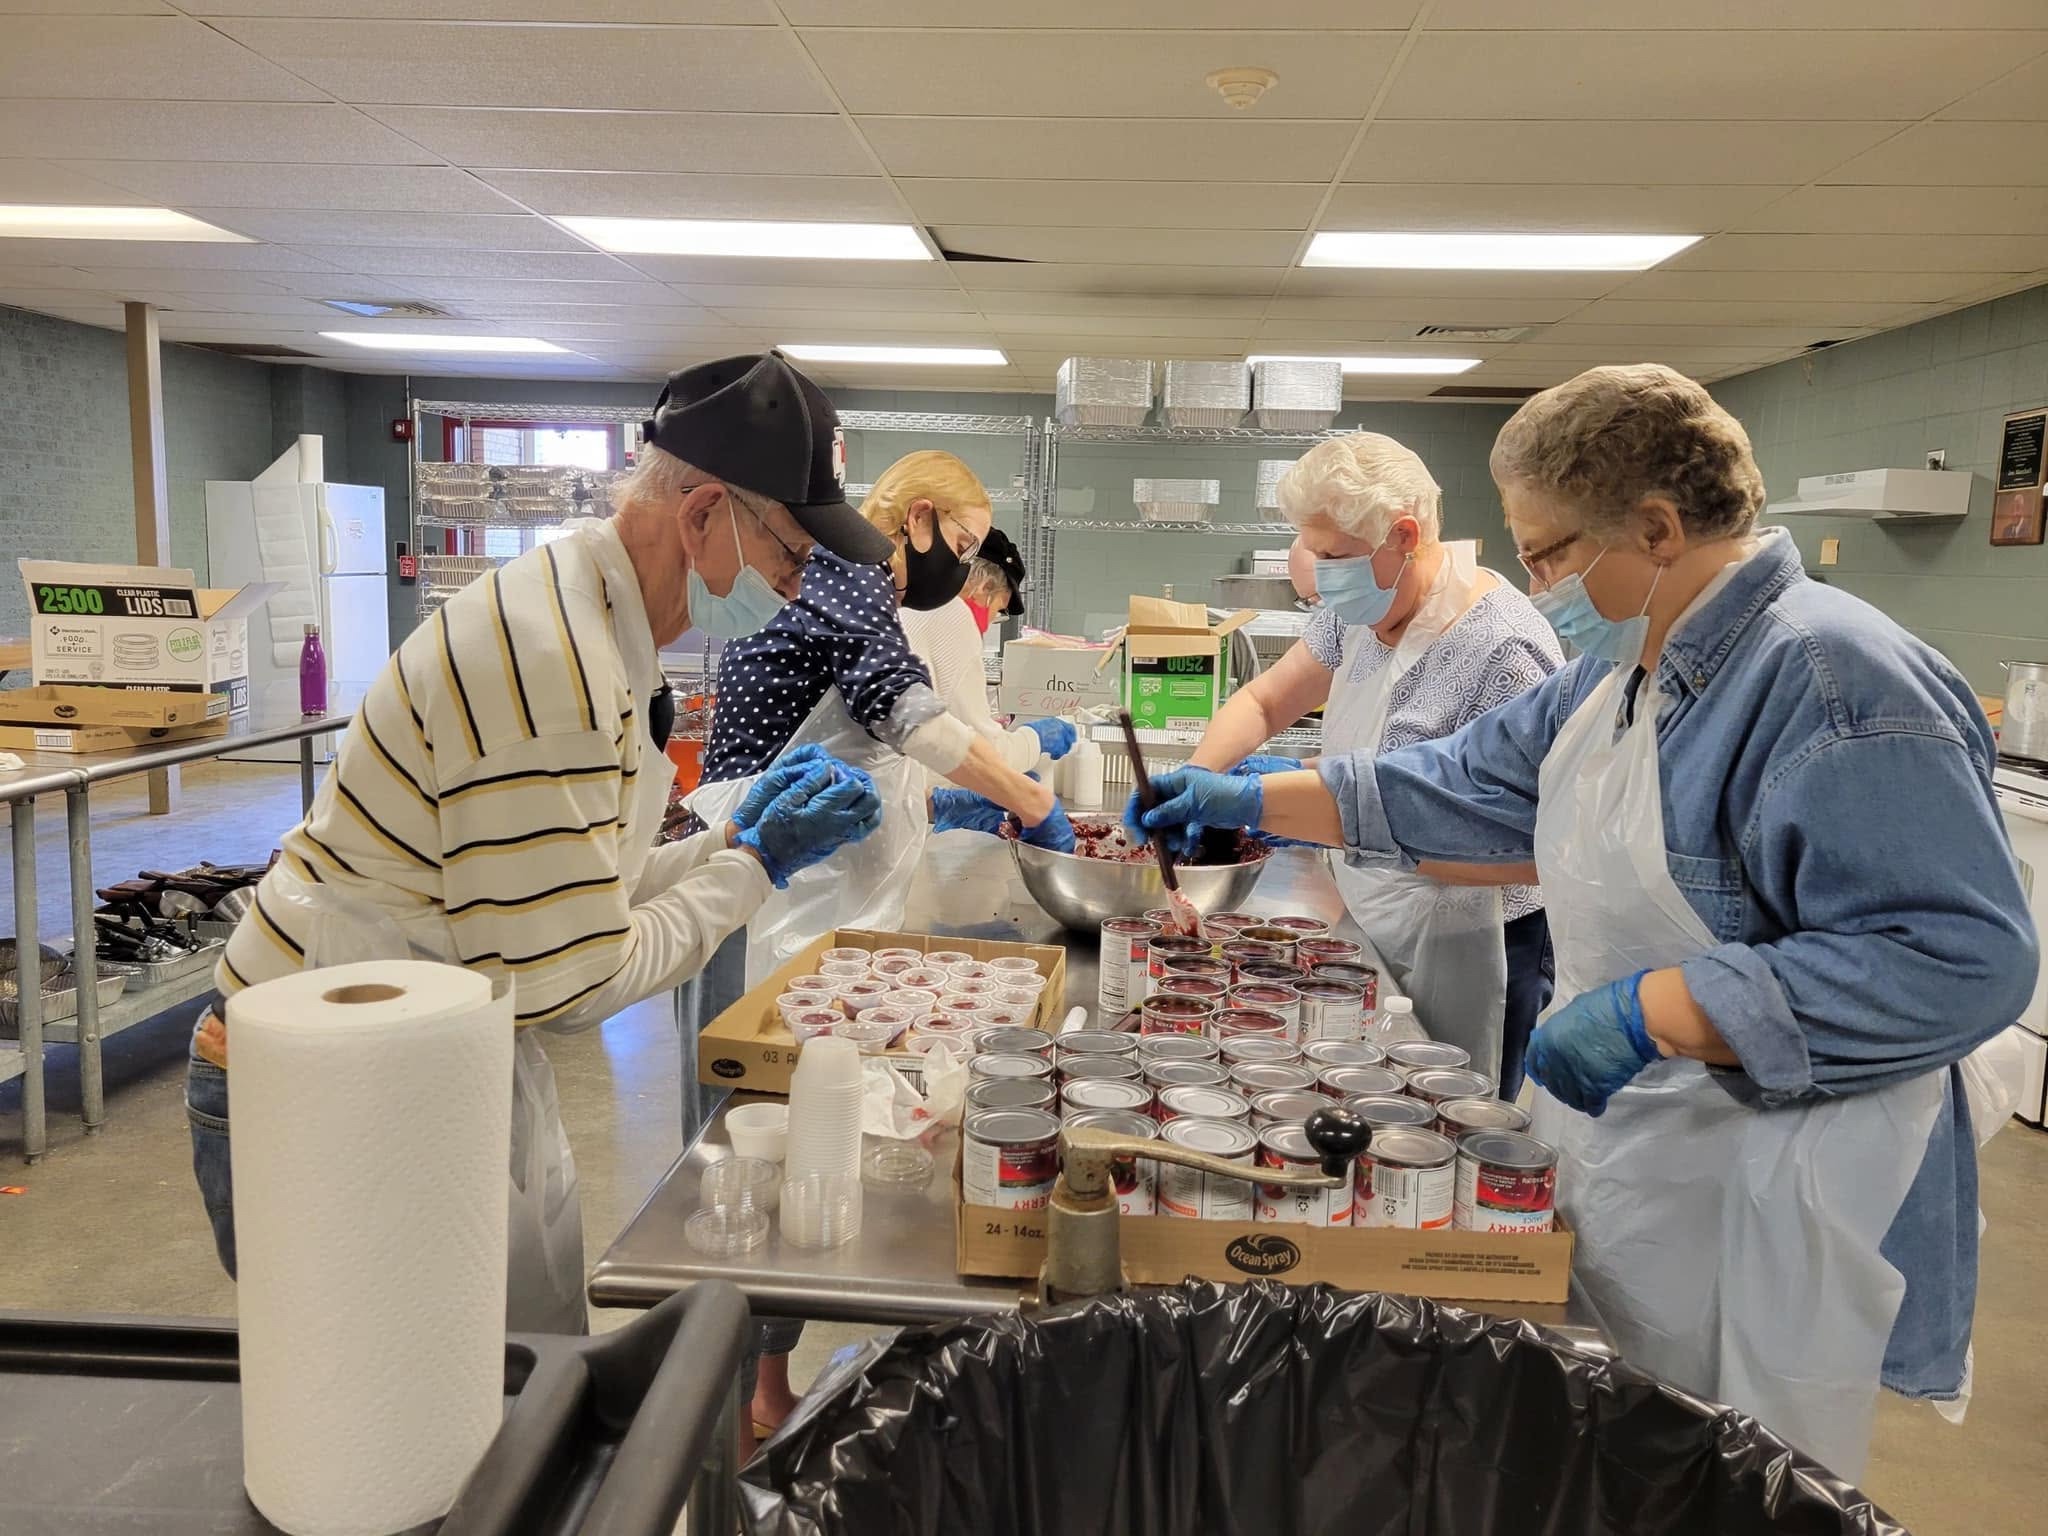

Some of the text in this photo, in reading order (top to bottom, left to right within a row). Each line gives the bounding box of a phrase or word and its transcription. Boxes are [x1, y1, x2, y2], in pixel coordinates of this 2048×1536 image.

[39, 586, 104, 614] 2500
[116, 589, 160, 598] CLEAR PLASTIC
[125, 597, 163, 616] LIDS
[56, 645, 92, 654] SERVICE
[1167, 655, 1204, 673] 2500
[233, 686, 247, 708] LIDS
[762, 1050, 779, 1064] 03
[985, 1223, 1001, 1235] 24
[1014, 1224, 1046, 1239] 14oz.
[1231, 1245, 1292, 1271] Ocean Spray
